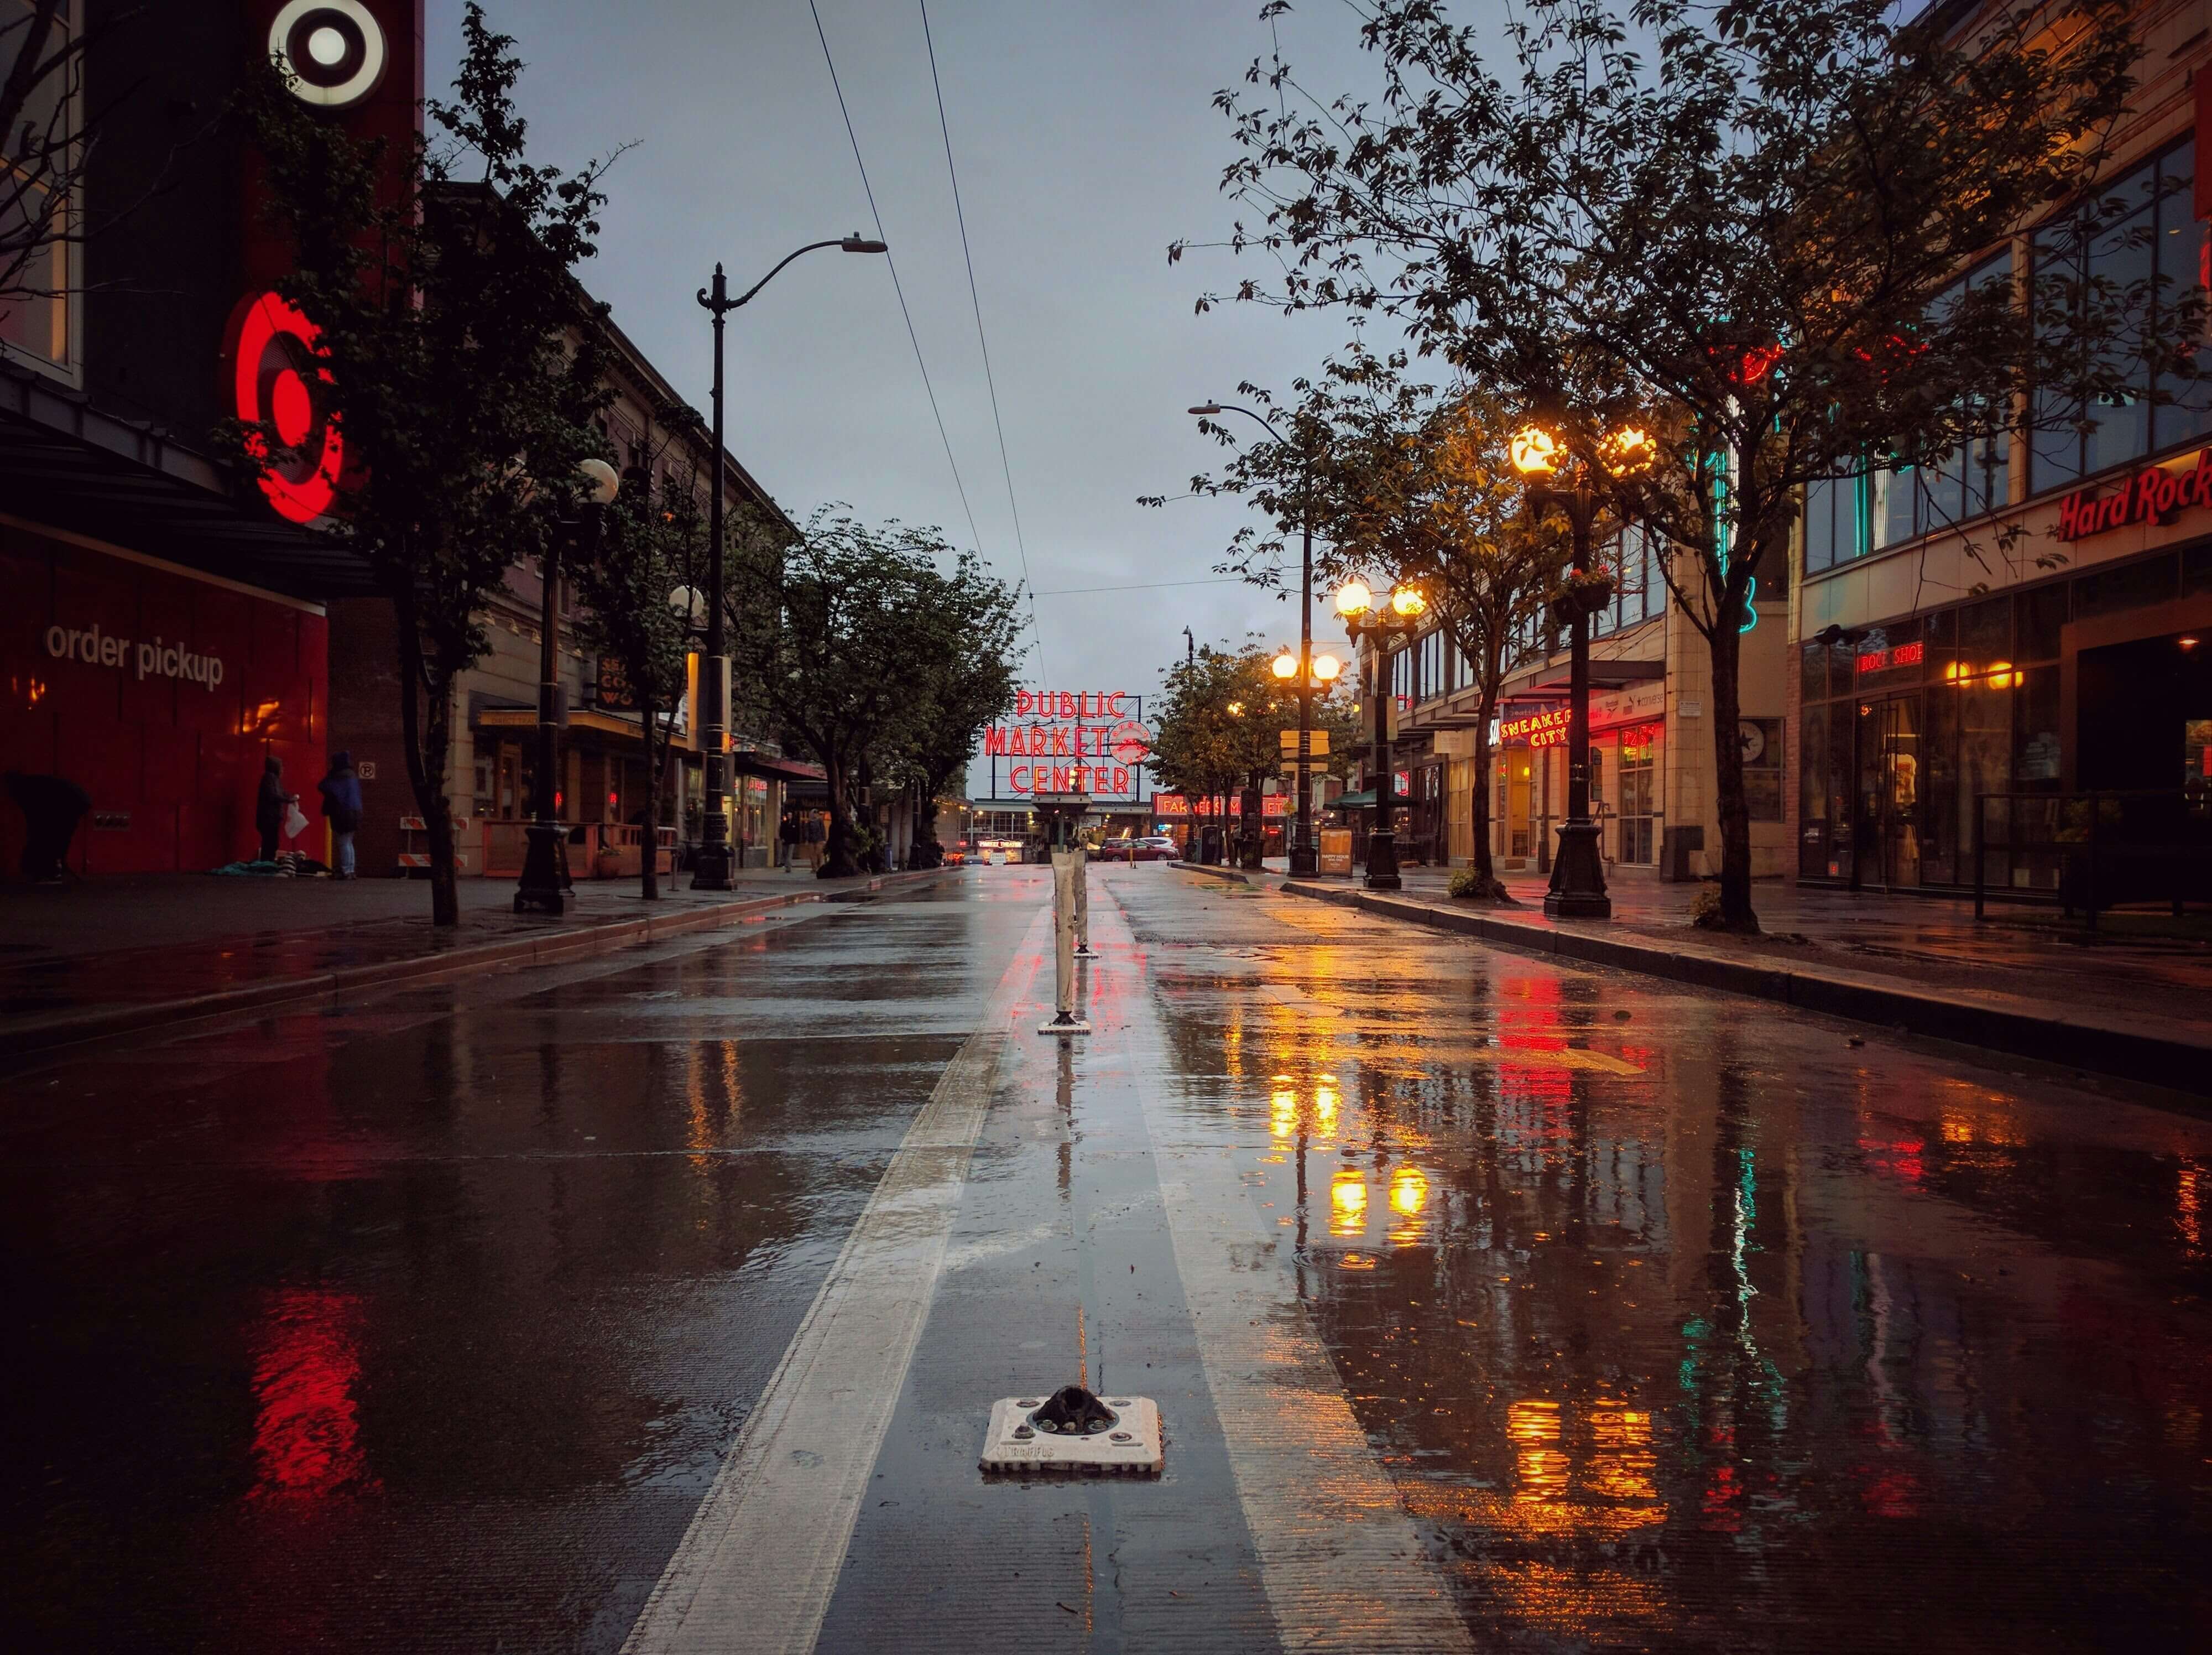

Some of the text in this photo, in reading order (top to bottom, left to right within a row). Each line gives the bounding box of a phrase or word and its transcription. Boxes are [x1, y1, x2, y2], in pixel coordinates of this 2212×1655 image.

[2057, 448, 2212, 543] Hard Rock
[46, 623, 223, 693] order pickup
[1018, 690, 1125, 718] PUBLIC
[985, 726, 1108, 757] MARKET
[1530, 727, 1567, 746] CITY
[1010, 766, 1129, 794] CENTER
[1164, 801, 1219, 814] FARERS
